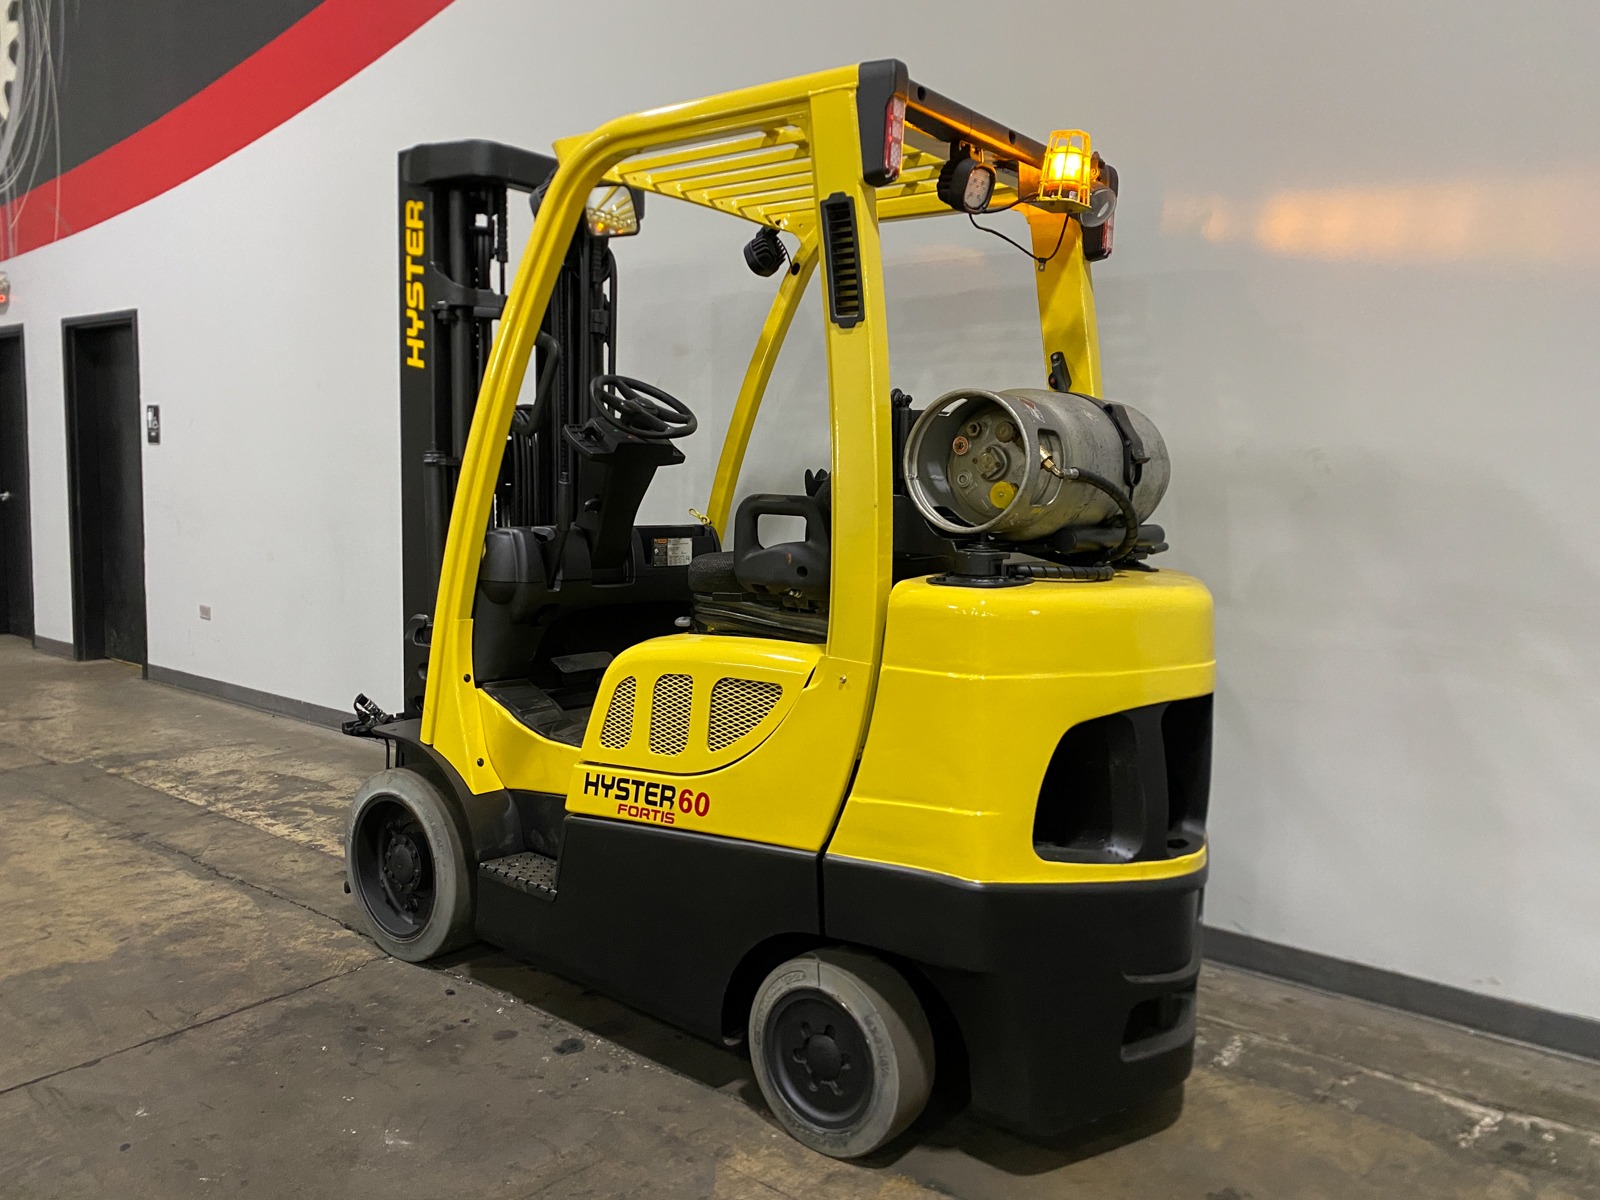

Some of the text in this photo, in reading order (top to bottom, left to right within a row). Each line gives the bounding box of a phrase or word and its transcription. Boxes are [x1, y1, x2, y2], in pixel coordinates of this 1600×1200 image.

[405, 199, 426, 369] HYSTER
[584, 772, 711, 817] HYSTER 60
[617, 803, 675, 824] FORTIS
